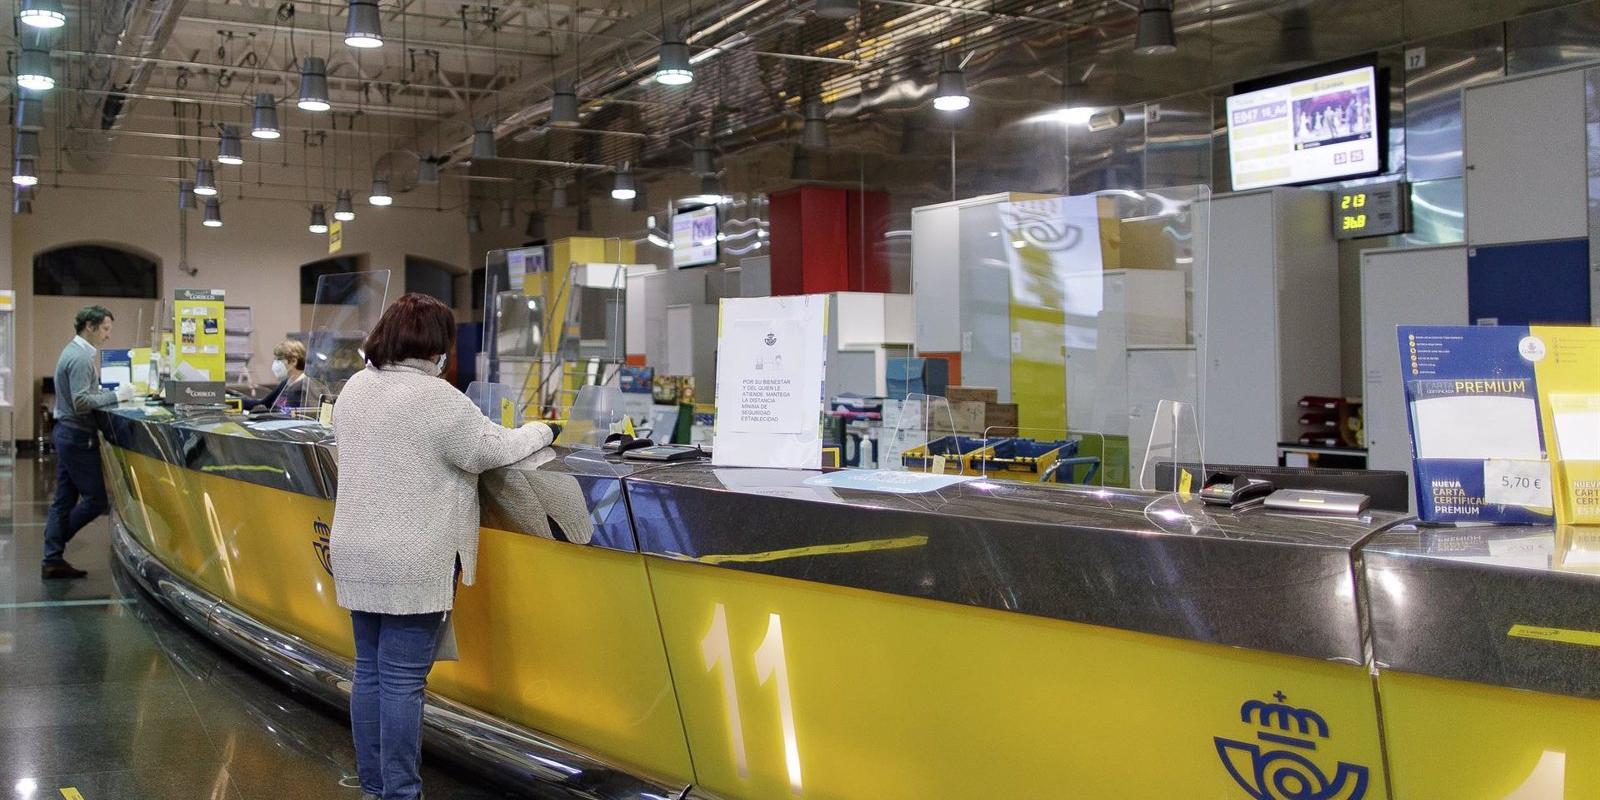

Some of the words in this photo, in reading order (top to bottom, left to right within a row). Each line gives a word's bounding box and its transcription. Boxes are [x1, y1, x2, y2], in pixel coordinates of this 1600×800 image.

[1410, 55, 1421, 67] 17
[1341, 194, 1366, 209] 213
[1455, 381, 1526, 393] PREMIUM
[1432, 480, 1461, 488] NUEVA
[1502, 476, 1530, 489] 5,70
[1534, 479, 1542, 490] €
[1433, 488, 1466, 496] CARTA
[1435, 506, 1480, 515] PREMIUM
[700, 603, 804, 795] 11
